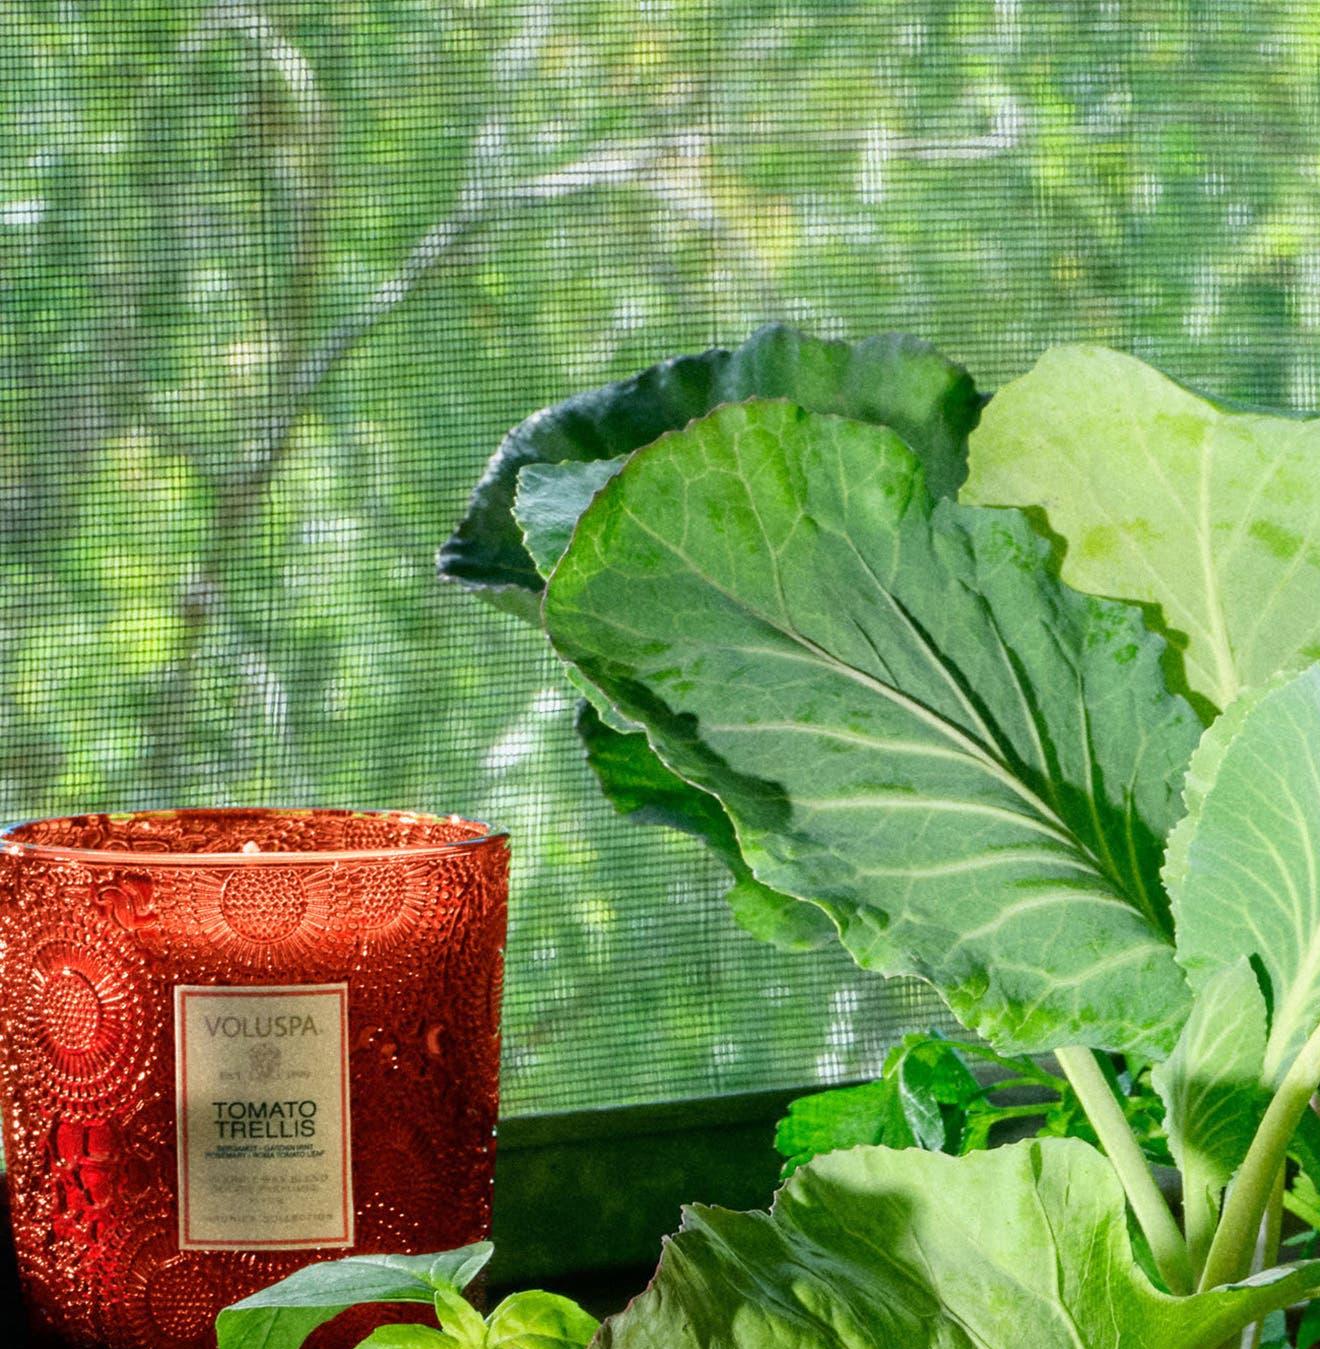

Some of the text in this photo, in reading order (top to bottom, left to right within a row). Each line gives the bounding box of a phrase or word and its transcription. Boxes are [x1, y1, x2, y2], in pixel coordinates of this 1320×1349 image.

[205, 1015, 318, 1038] VOLUSPA
[212, 1100, 317, 1120] TOMATO
[214, 1119, 316, 1139] TRELLIS
